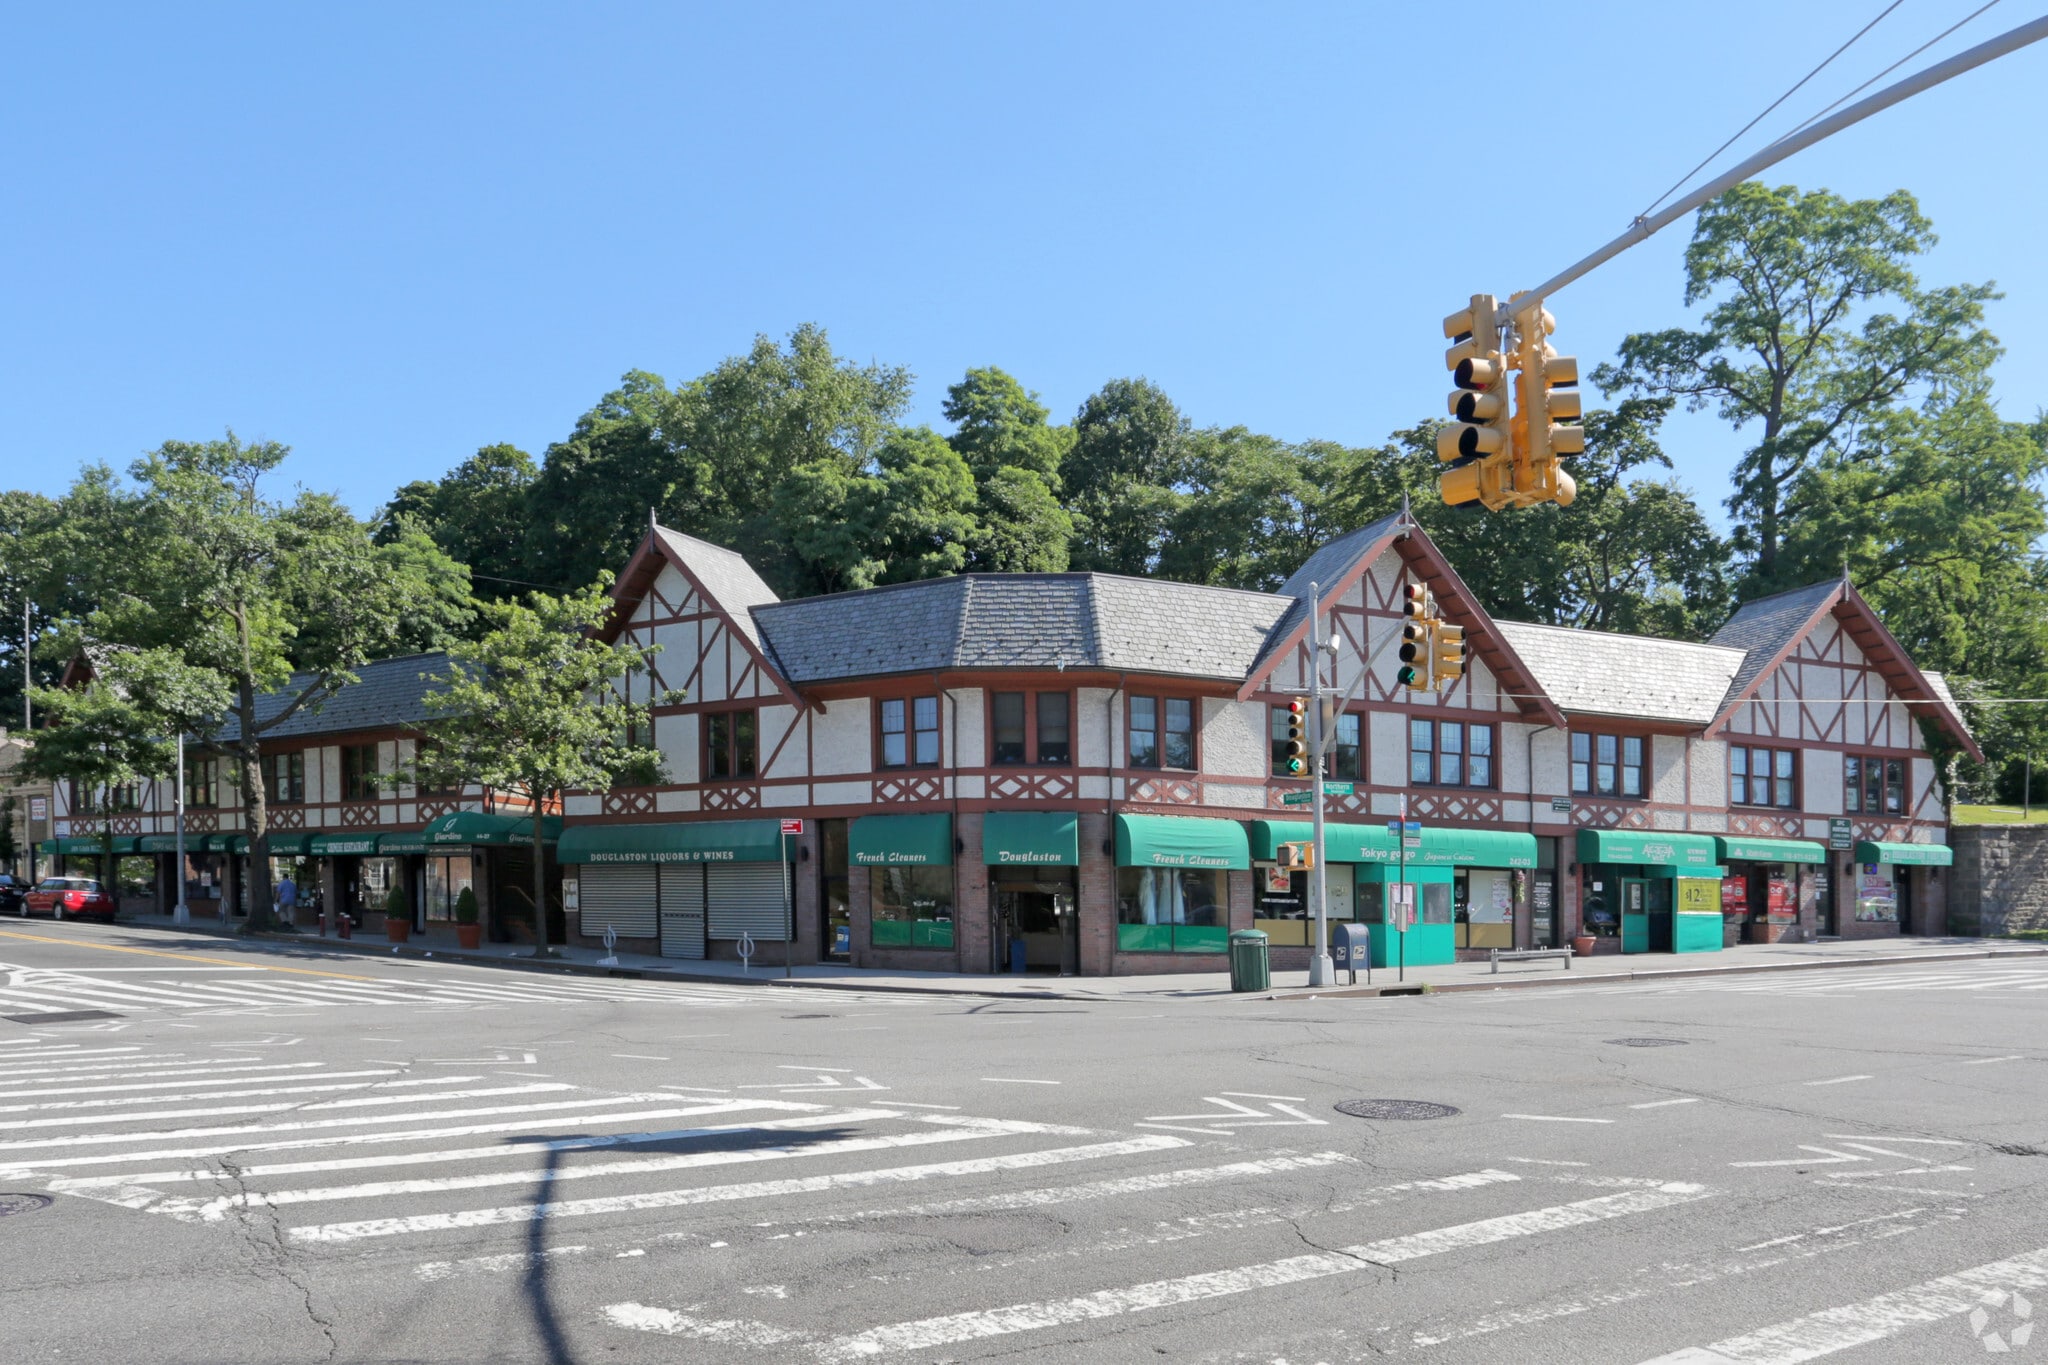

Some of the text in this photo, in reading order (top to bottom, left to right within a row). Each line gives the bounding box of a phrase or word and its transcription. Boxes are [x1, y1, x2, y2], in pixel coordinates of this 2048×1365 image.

[435, 833, 462, 842] Giardino
[509, 834, 535, 843] Giardin
[590, 851, 734, 862] DOUGLASTON LIQUORS & WINES
[856, 852, 927, 862] French Cleaners
[1000, 850, 1061, 863] Douglaston
[1360, 848, 1387, 860] Tokyo
[1424, 852, 1452, 861] Japanese
[1152, 853, 1230, 866] French Cleaners
